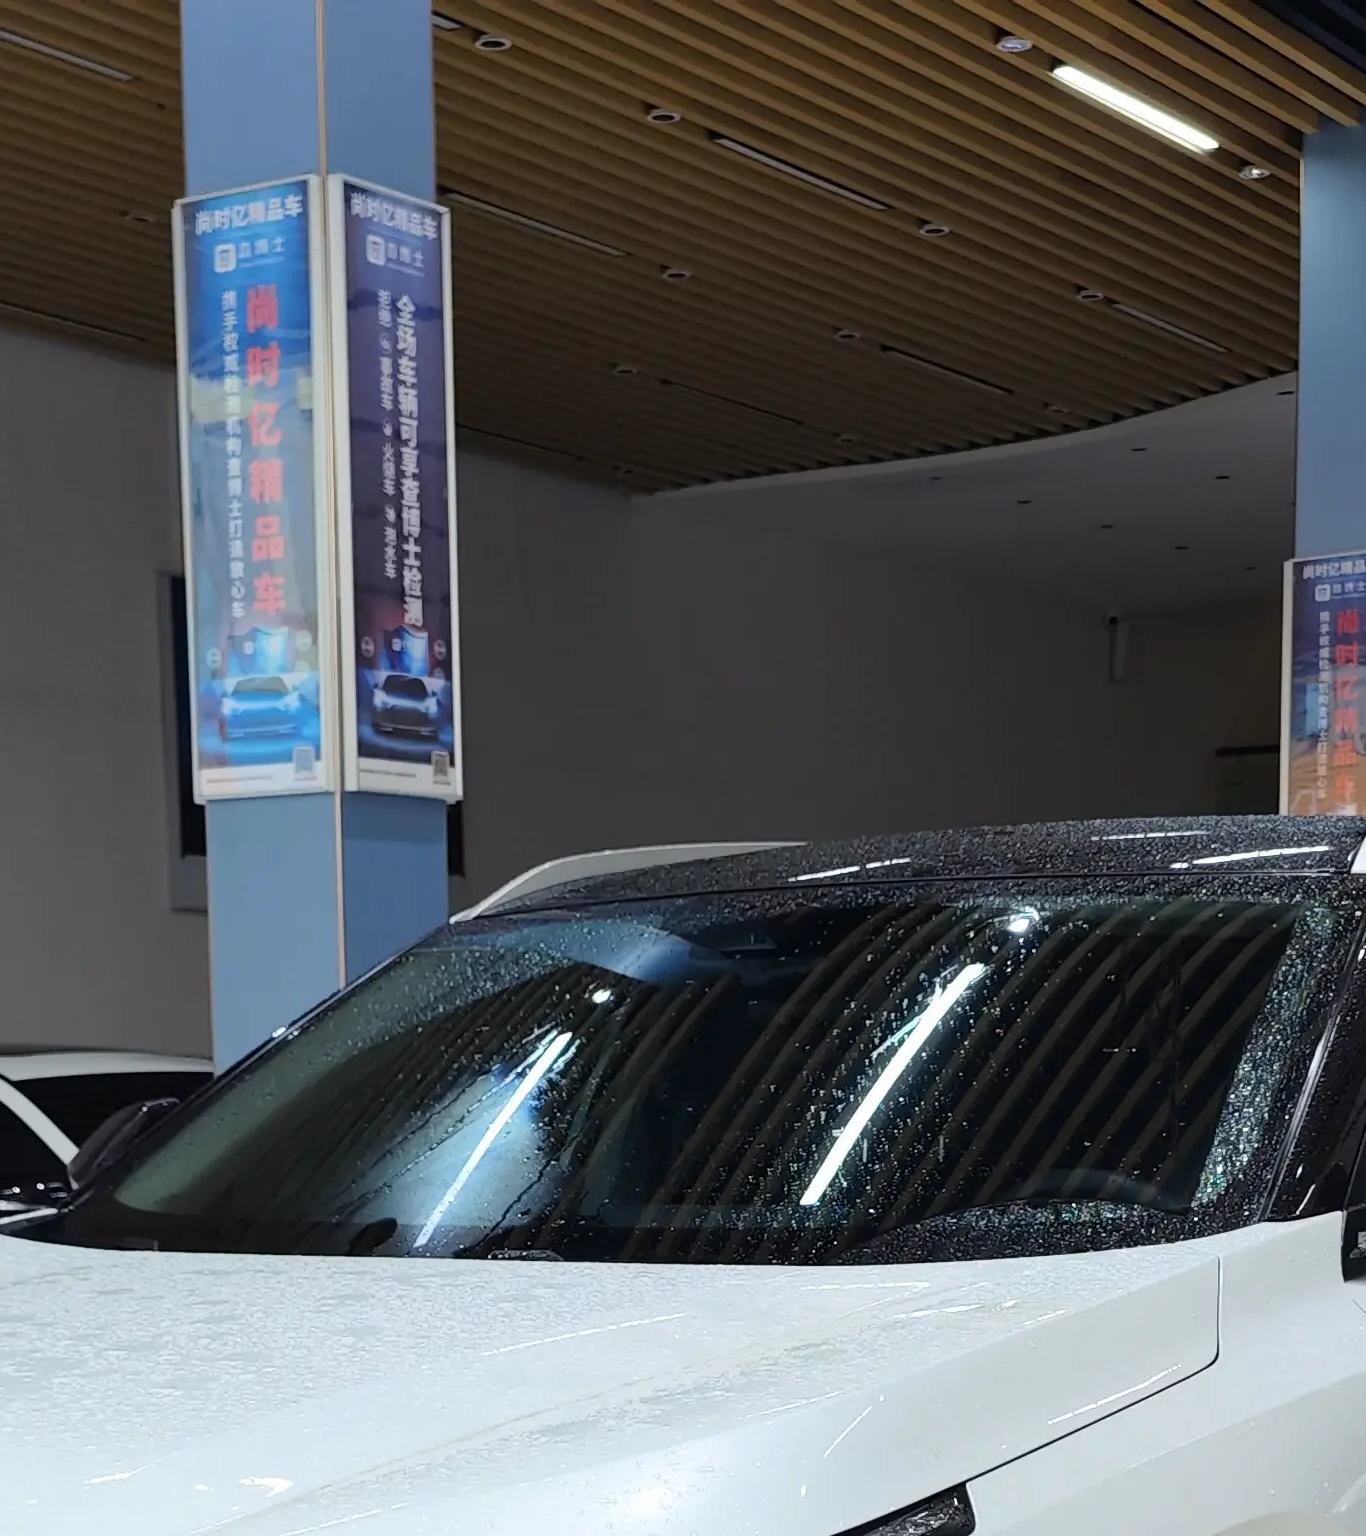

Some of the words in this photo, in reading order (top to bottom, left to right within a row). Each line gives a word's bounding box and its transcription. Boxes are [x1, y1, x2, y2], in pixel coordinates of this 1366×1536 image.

[195, 193, 303, 236] 尚时亿精品车
[350, 192, 438, 240] 尚时亿精品车
[245, 283, 286, 617] 尚时亿精品车
[1334, 608, 1361, 799] 尚时亿精品车
